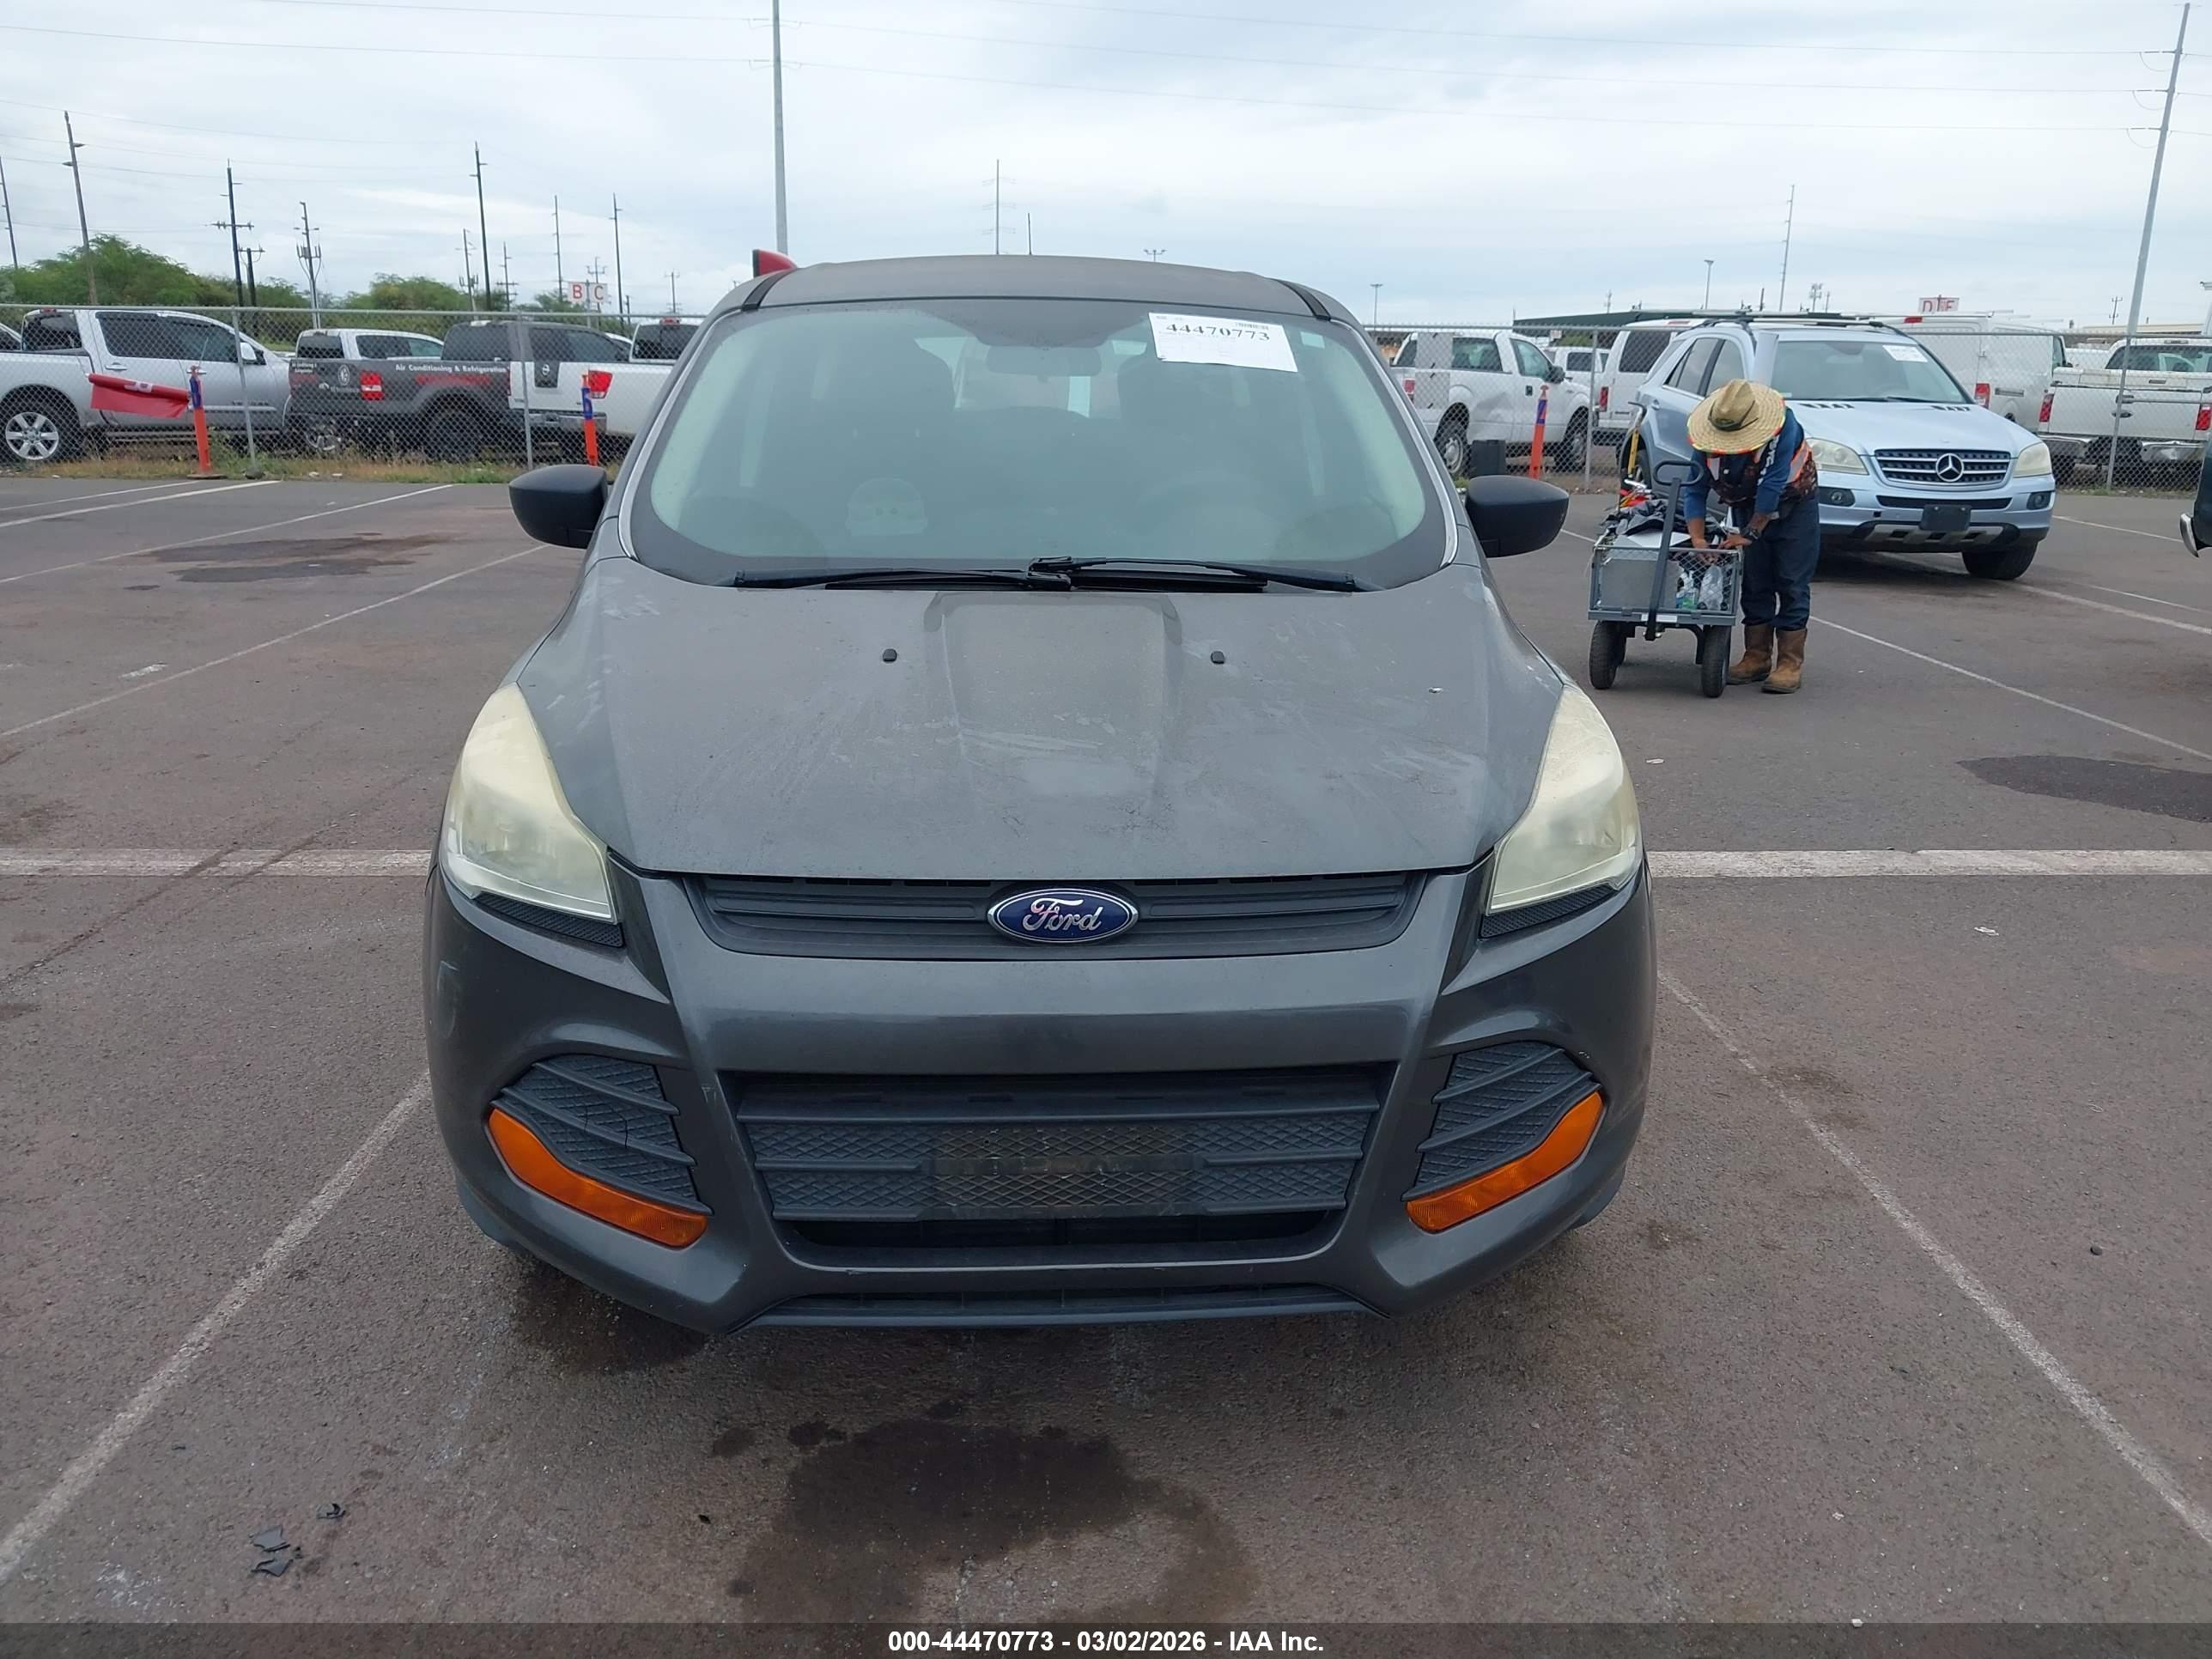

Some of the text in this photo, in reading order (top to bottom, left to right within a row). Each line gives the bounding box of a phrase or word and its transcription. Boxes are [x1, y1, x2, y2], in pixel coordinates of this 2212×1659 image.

[573, 284, 604, 300] B C
[1166, 324, 1270, 341] 44470773
[1023, 897, 1103, 931] Ford
